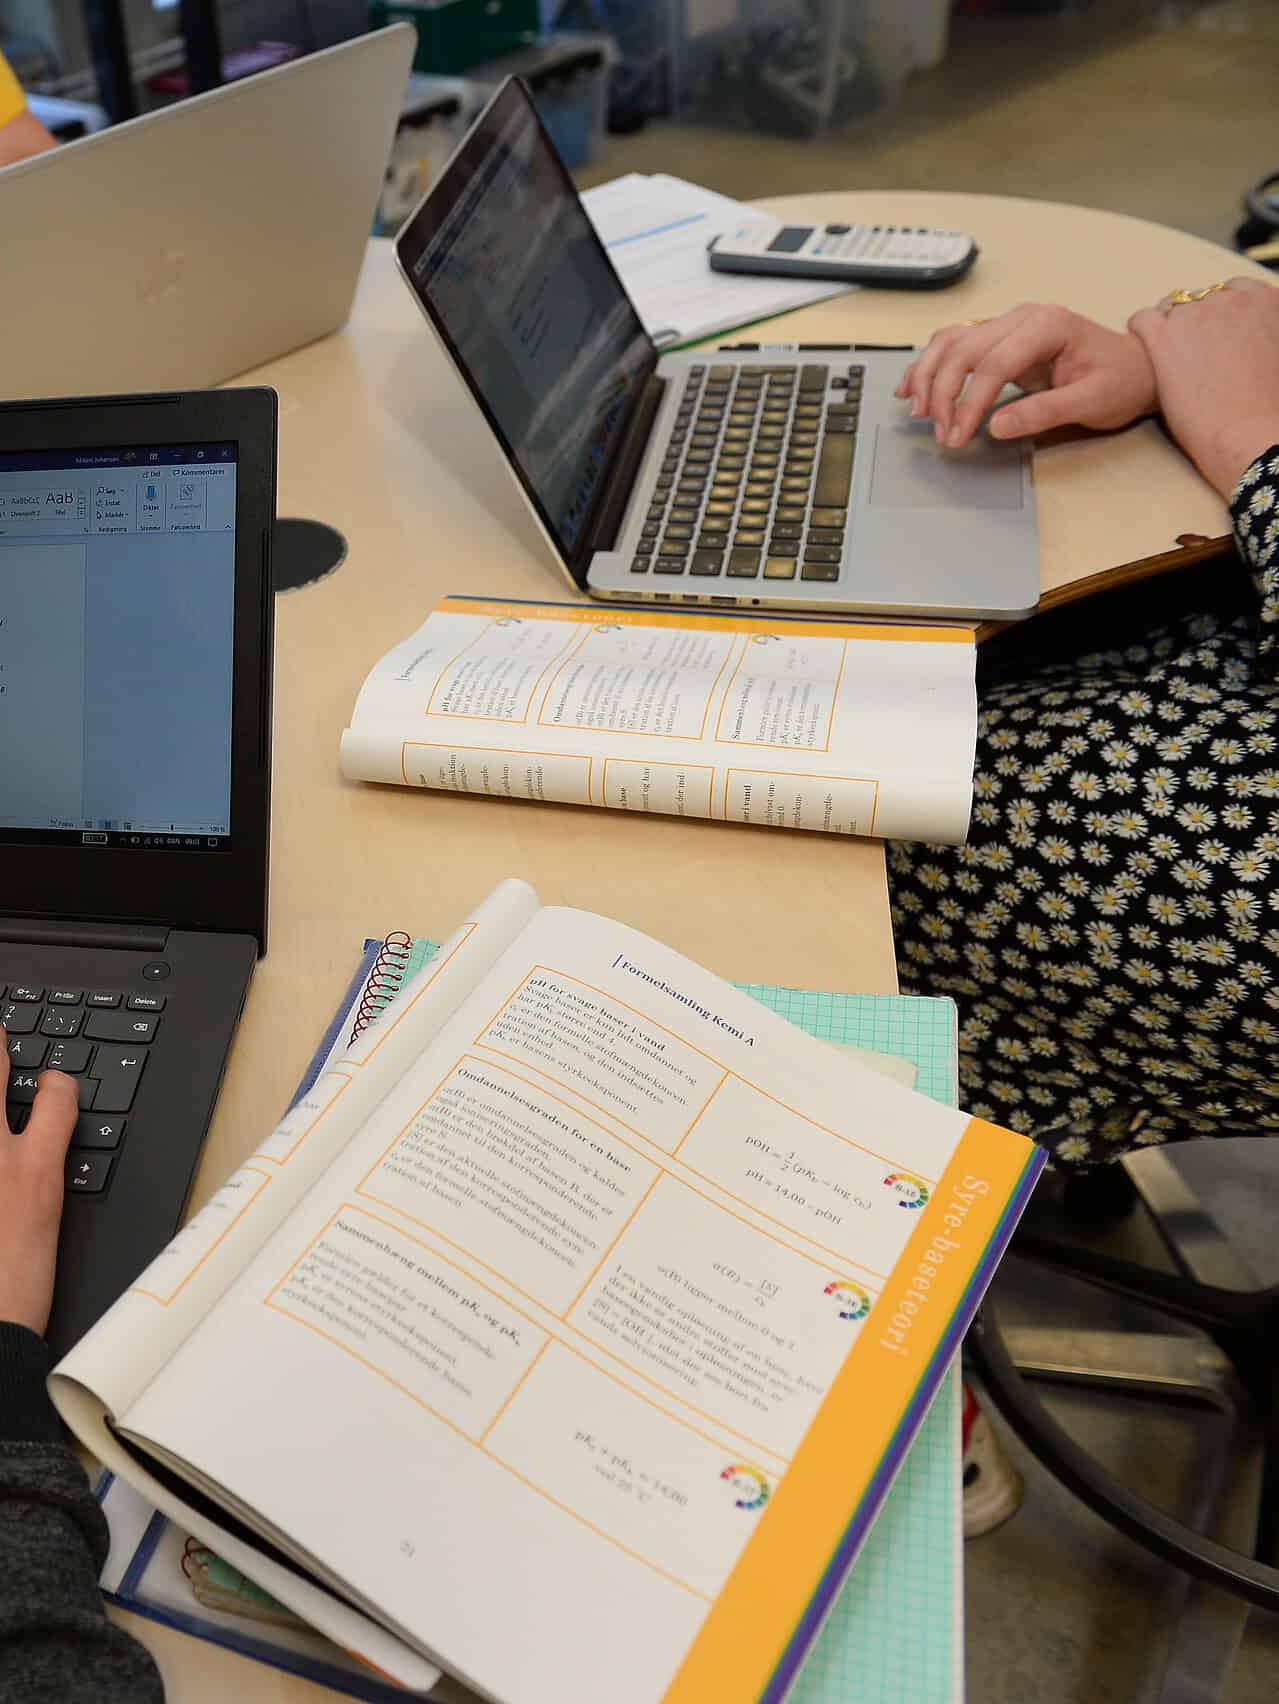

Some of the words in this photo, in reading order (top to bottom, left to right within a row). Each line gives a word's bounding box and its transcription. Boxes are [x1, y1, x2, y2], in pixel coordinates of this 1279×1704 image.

[134, 997, 157, 1006] Delete
[548, 984, 565, 995] for
[566, 993, 597, 1011] svage
[599, 1007, 628, 1029] baser
[639, 1032, 666, 1052] vand
[621, 961, 711, 1020] Formelsamling
[712, 1015, 745, 1040] Kemi
[744, 1037, 754, 1047] A
[11, 1041, 22, 1053] Å
[457, 1068, 569, 1132] Omdannelsesgraden
[571, 1128, 587, 1143] for
[589, 1143, 604, 1155] en
[606, 1151, 631, 1172] base
[881, 1174, 991, 1357] Syre-baseteori
